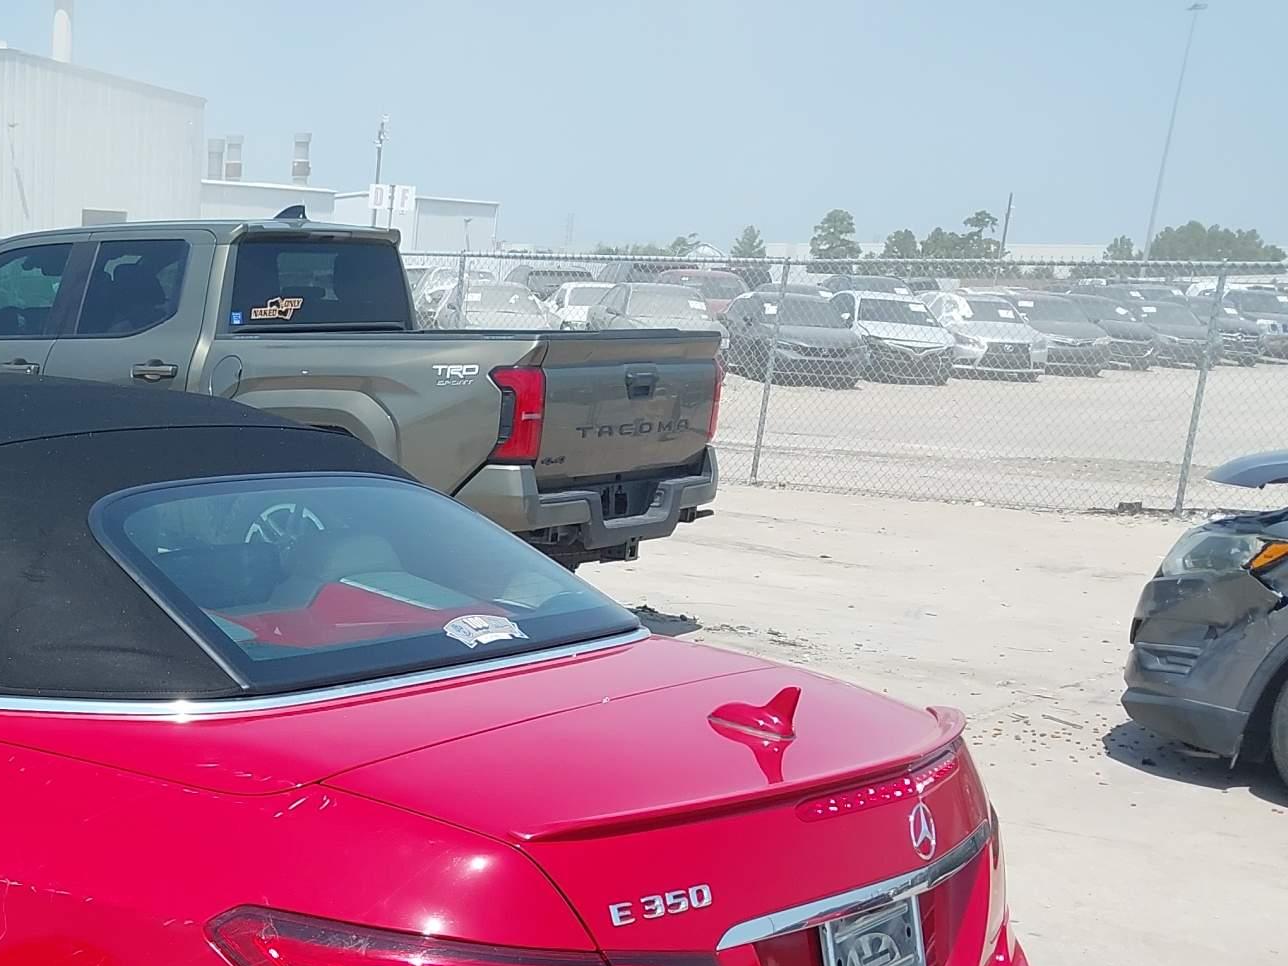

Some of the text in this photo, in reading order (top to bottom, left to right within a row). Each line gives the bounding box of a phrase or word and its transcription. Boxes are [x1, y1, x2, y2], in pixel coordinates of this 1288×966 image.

[374, 187, 384, 206] D
[400, 188, 409, 209] F
[253, 308, 278, 317] NAKED
[432, 364, 479, 379] TRD
[576, 419, 689, 439] TACOMA
[608, 883, 713, 927] E 350
